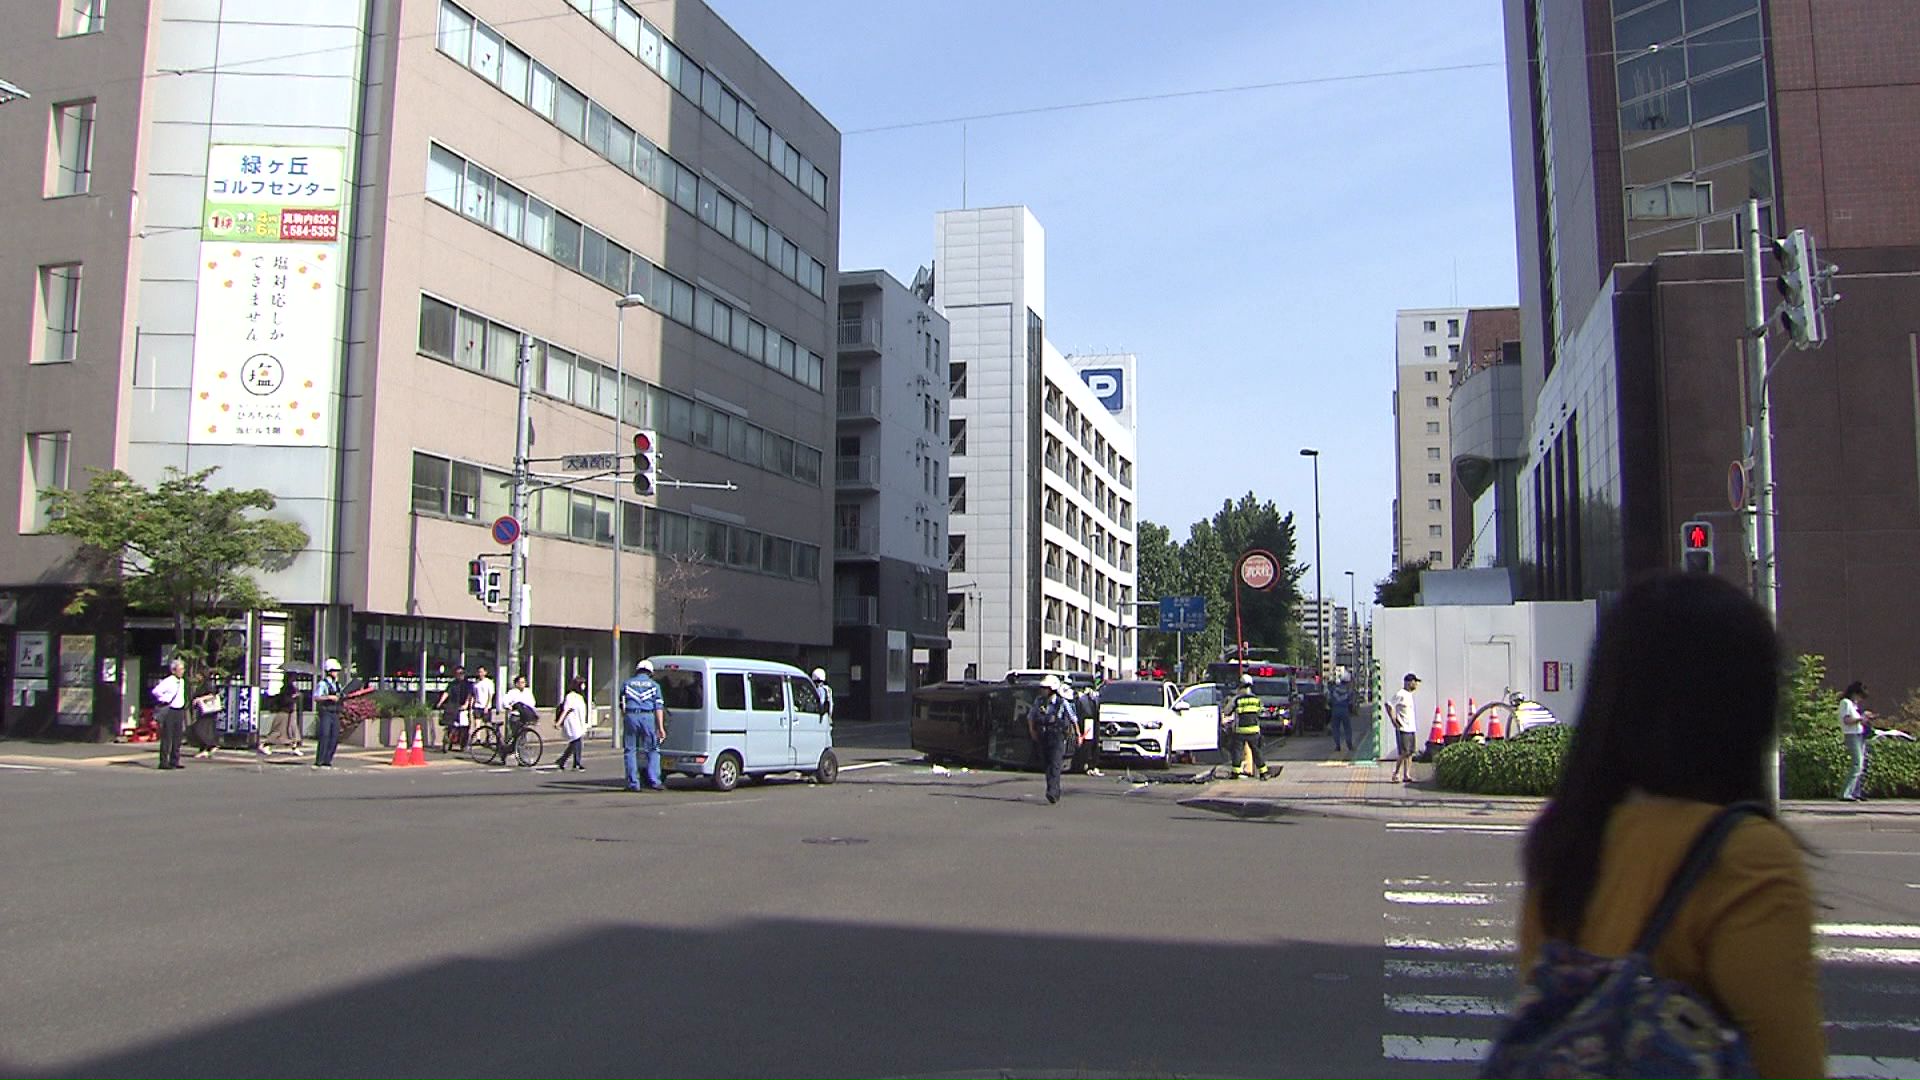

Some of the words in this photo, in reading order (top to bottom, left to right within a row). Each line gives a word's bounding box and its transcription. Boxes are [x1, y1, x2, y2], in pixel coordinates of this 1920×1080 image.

[213, 180, 336, 196] ゴルフセンター
[1088, 375, 1117, 398] P
